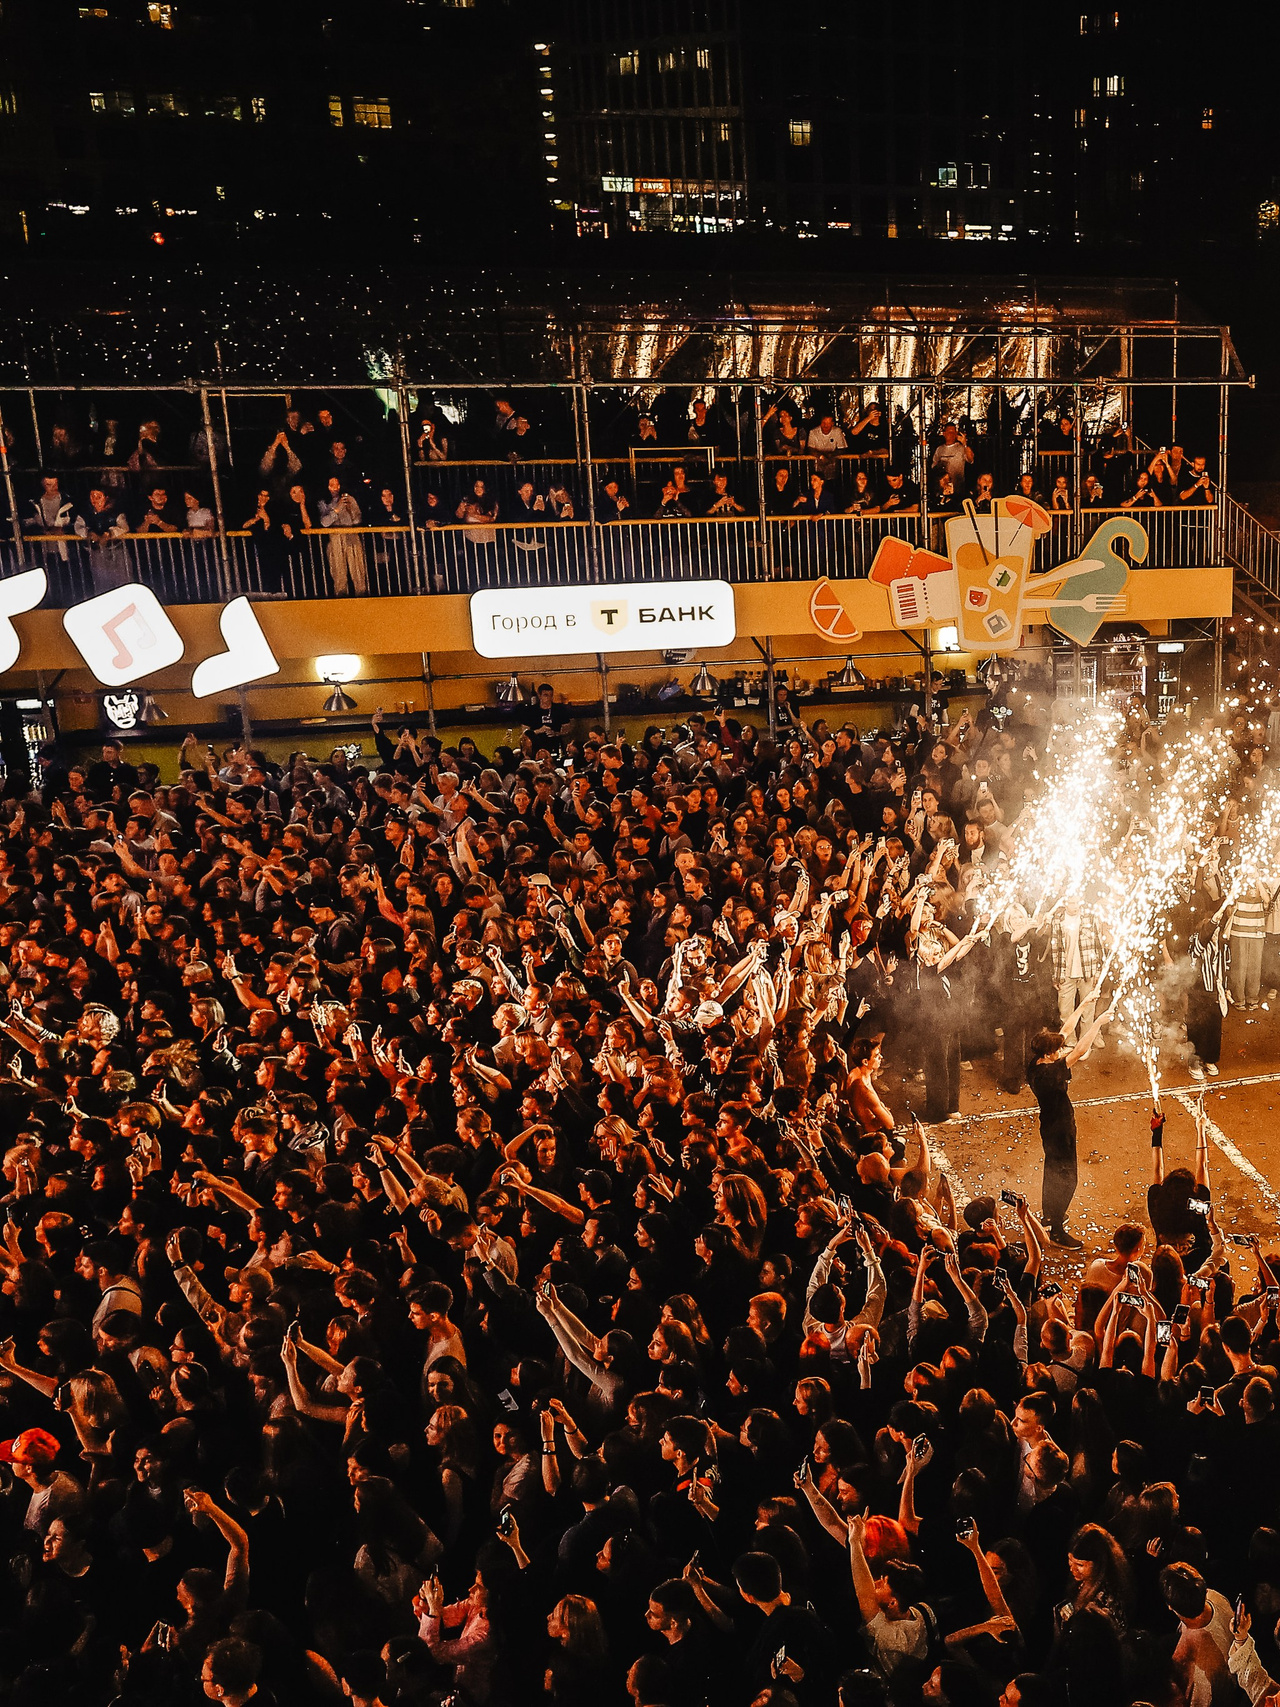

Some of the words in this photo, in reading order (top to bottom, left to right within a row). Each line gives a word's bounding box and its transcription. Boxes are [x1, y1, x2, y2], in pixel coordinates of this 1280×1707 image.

[491, 614, 557, 633] Город
[566, 613, 577, 627] в
[638, 605, 715, 624] БАНК
